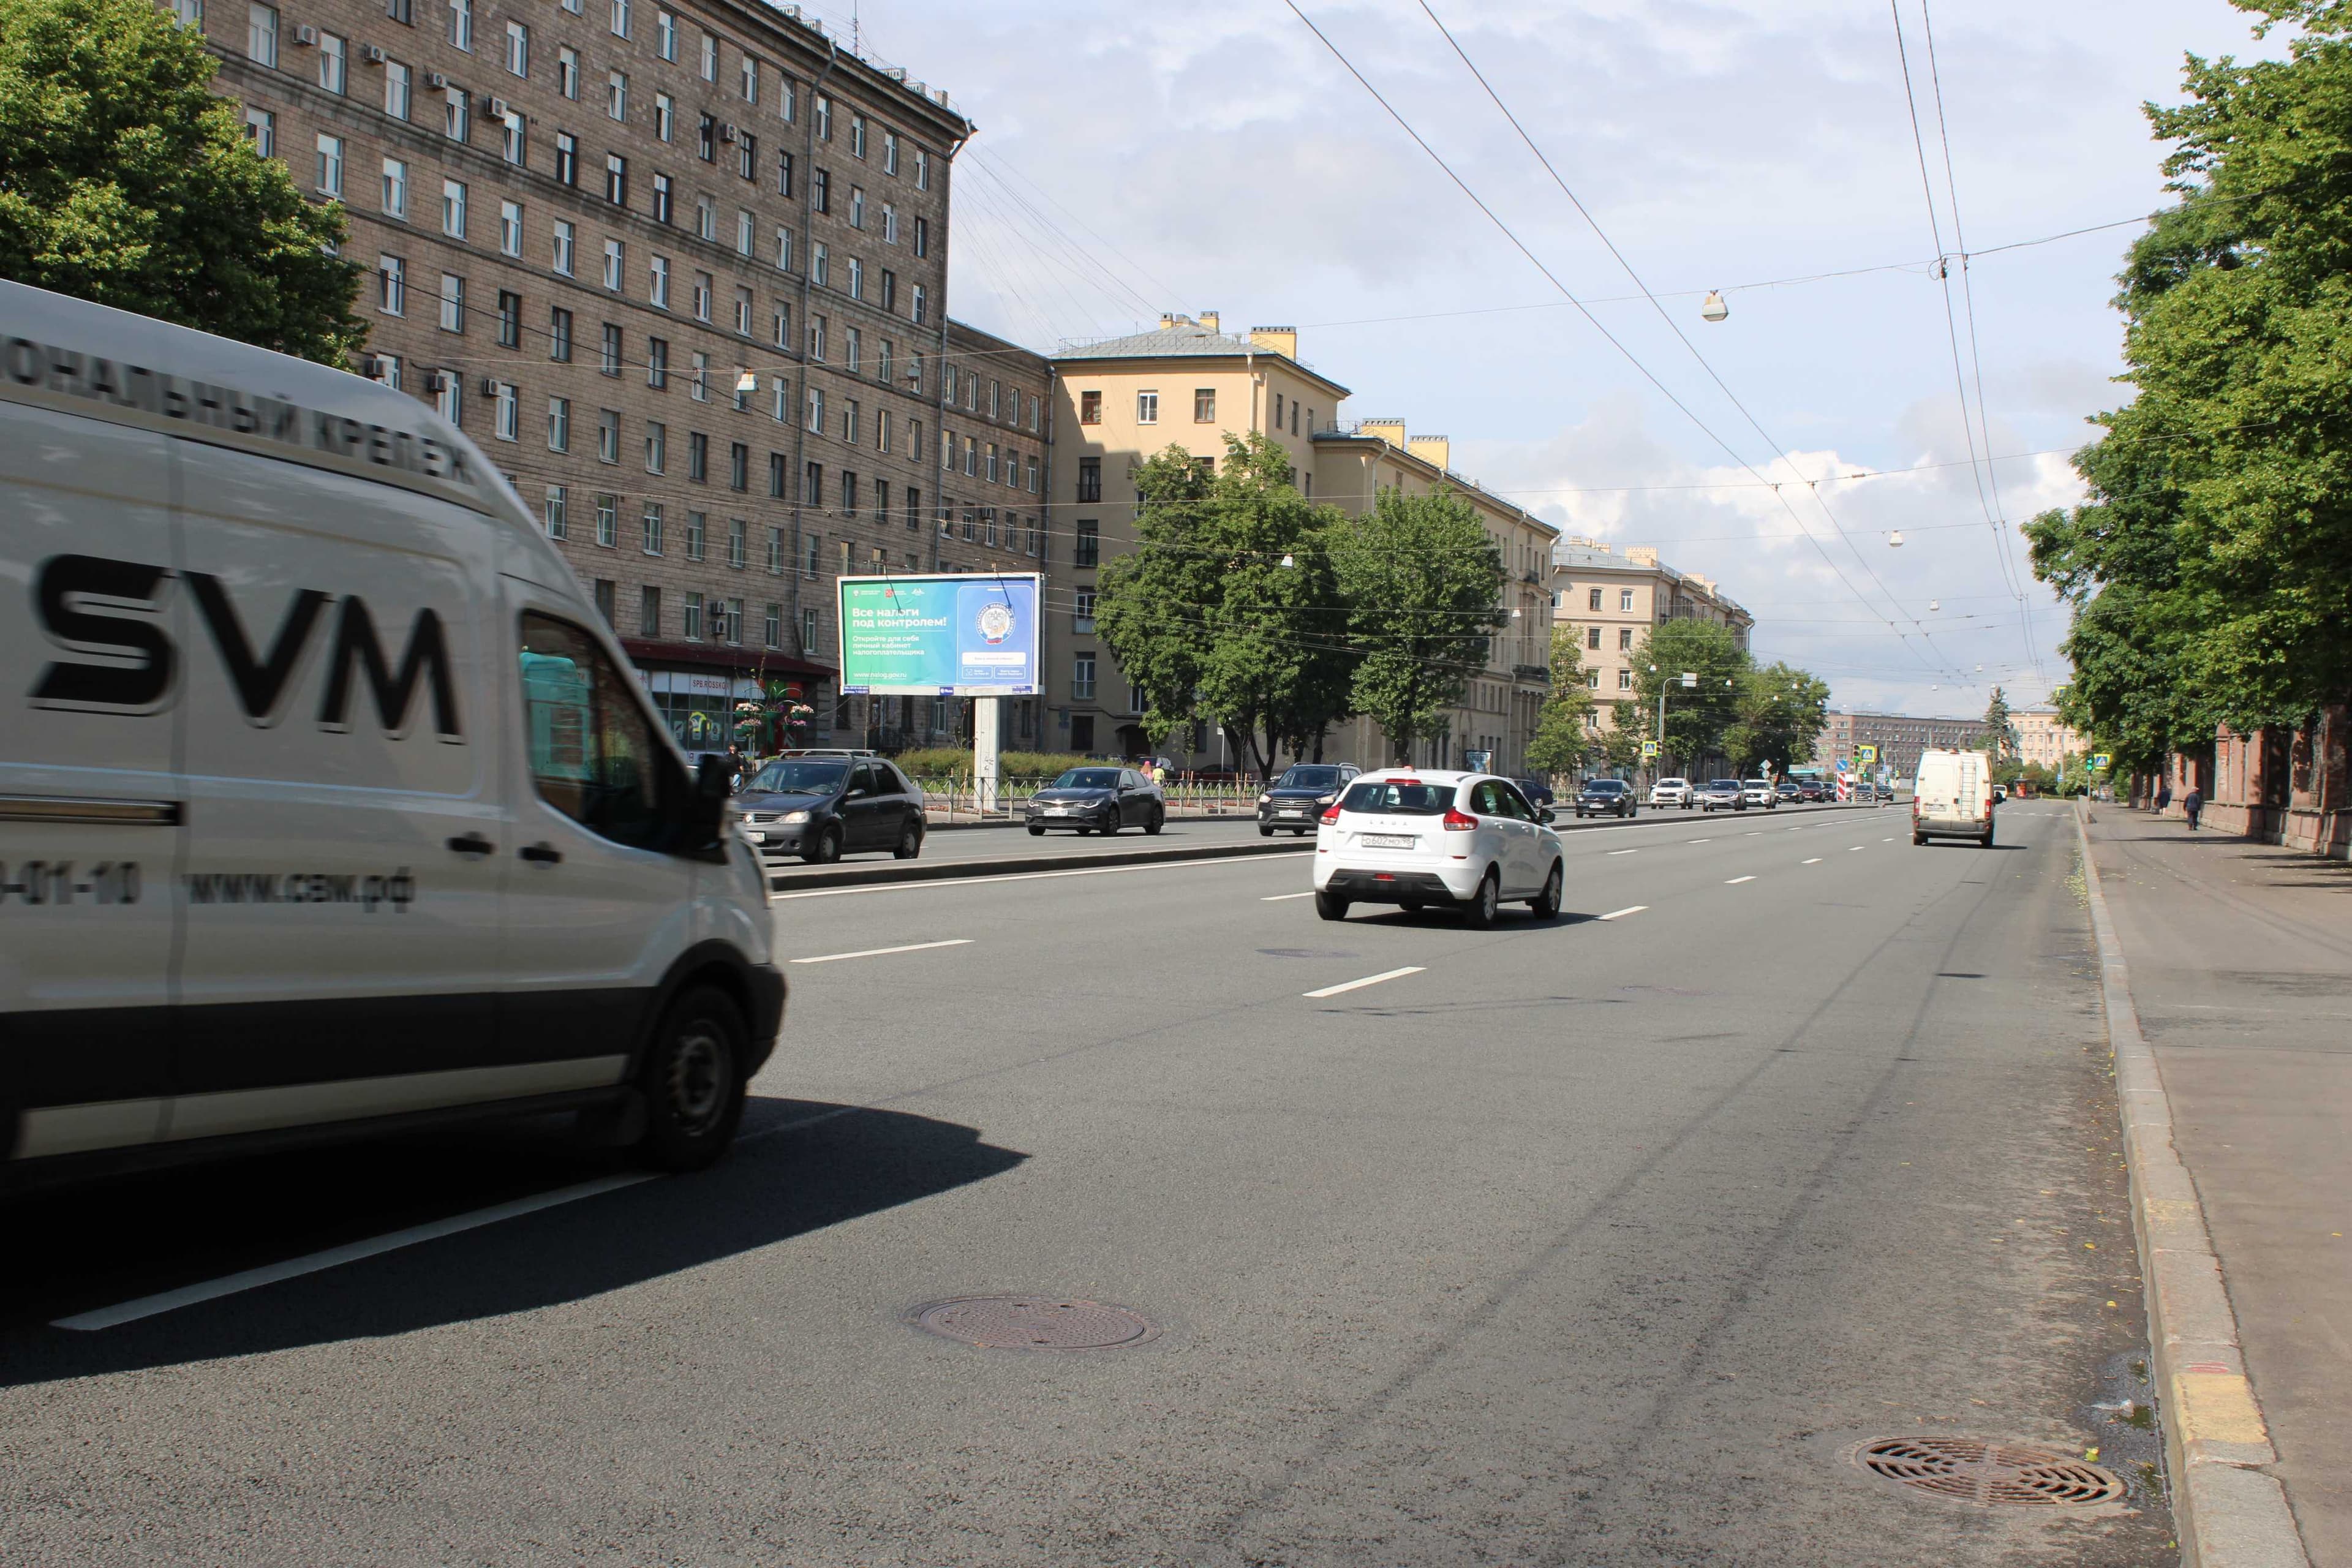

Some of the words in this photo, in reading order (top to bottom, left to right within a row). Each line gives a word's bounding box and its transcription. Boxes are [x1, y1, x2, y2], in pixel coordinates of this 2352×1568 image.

[0, 334, 300, 445] ОНАЛЬНЫЙ
[852, 608, 874, 617] Все
[876, 608, 919, 617] налоги
[852, 619, 875, 628] под
[878, 617, 947, 628] контролем!
[26, 553, 467, 746] SVM
[0, 860, 141, 905] -01-10
